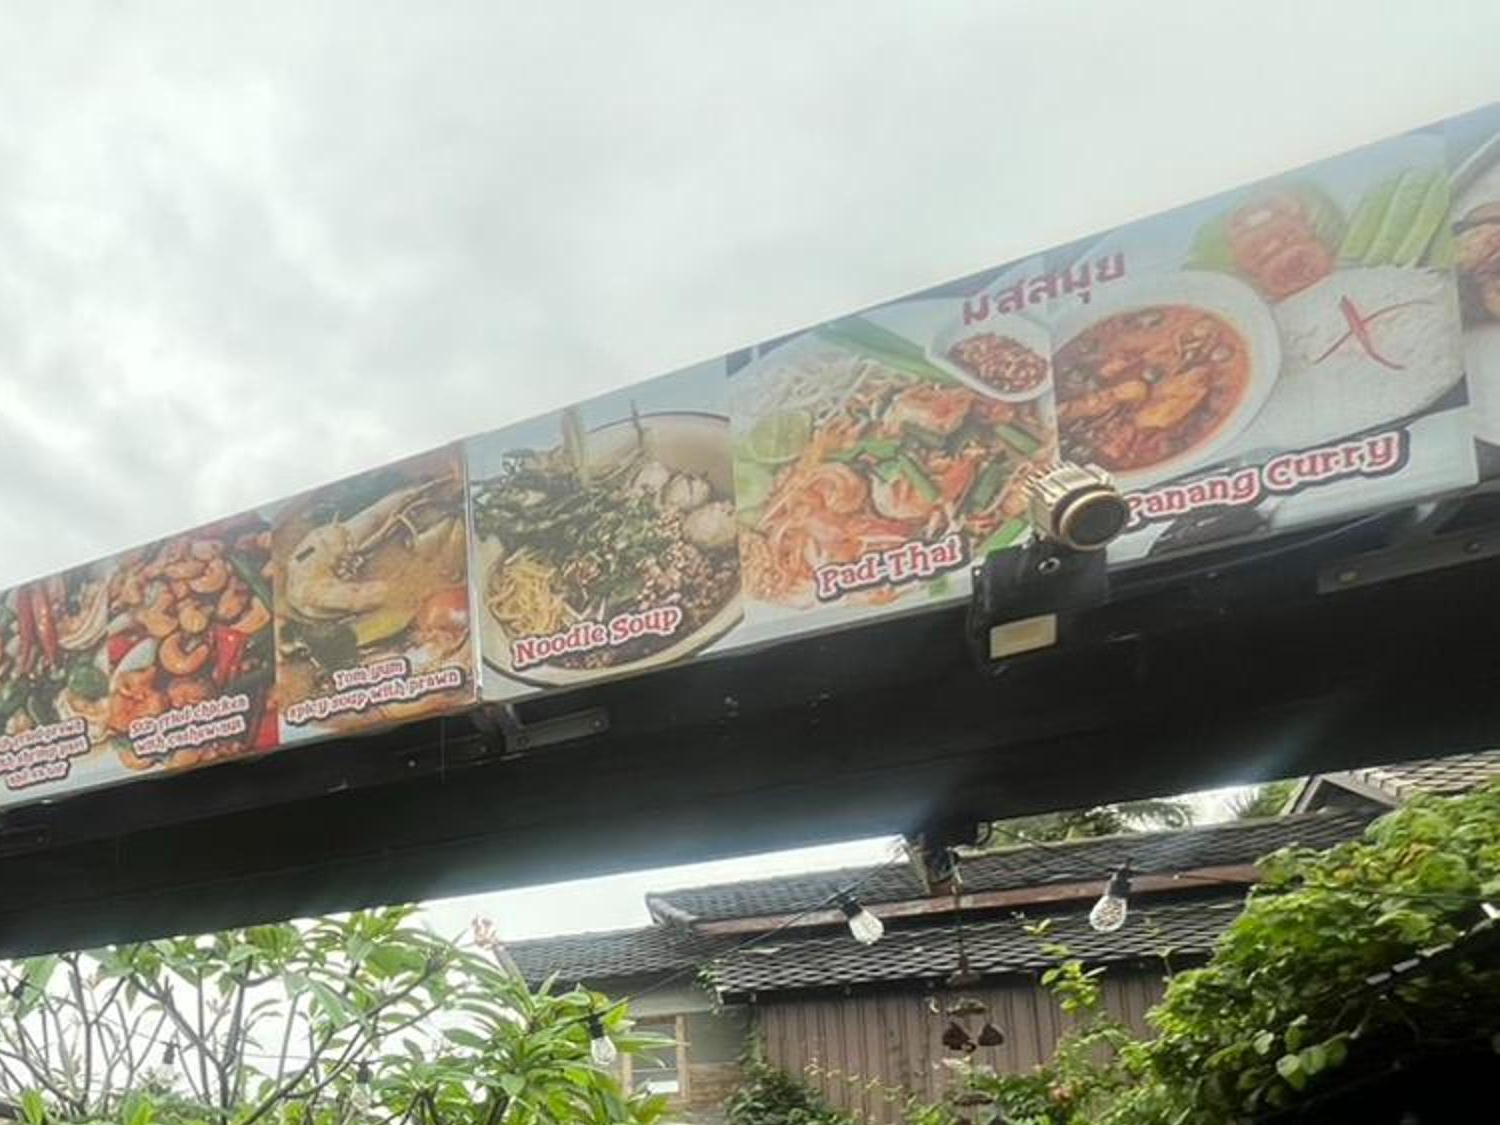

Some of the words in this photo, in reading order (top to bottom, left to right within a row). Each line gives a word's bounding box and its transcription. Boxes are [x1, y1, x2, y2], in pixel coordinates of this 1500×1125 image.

[1125, 469, 1258, 518] Panang
[1266, 435, 1396, 485] Curry
[514, 624, 606, 665] Noodle
[611, 608, 680, 640] Soup
[195, 694, 248, 718] chicken
[331, 690, 366, 712] soup
[370, 678, 406, 702] with
[407, 670, 460, 697] prawn
